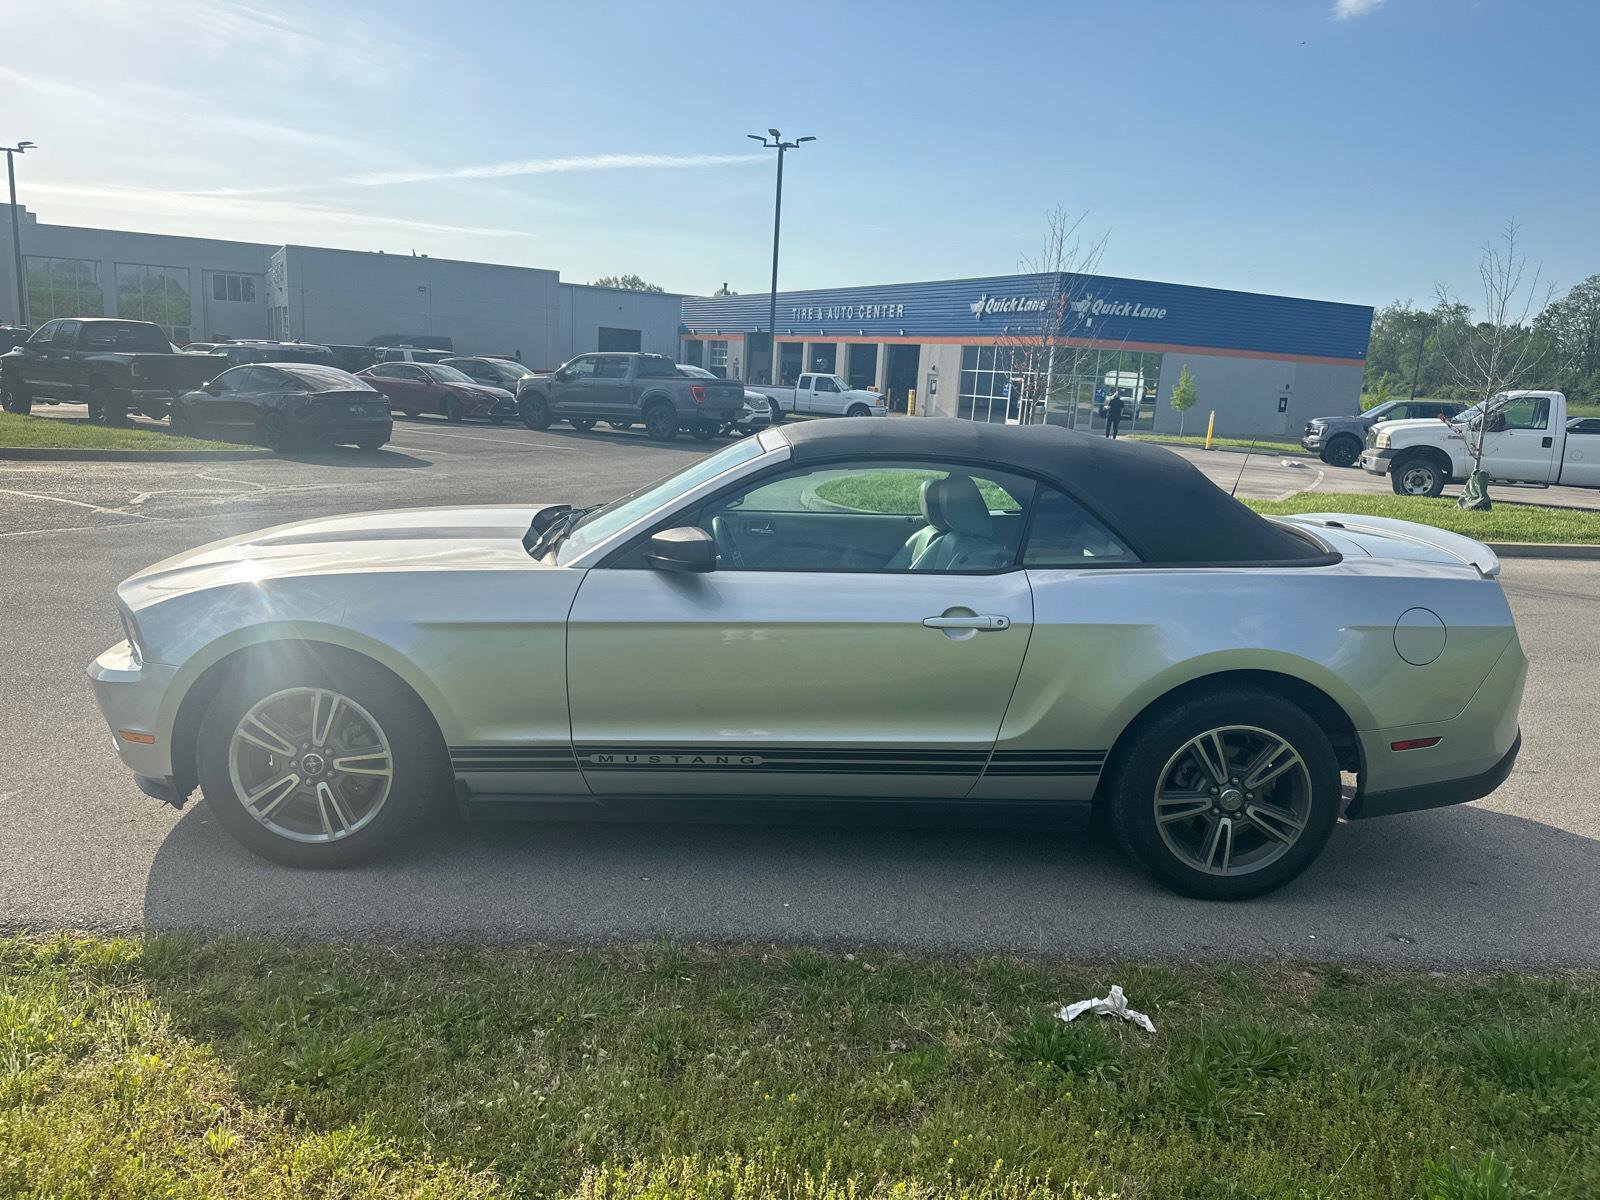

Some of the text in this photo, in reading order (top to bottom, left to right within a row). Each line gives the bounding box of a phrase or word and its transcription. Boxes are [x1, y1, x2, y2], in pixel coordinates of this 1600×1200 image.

[792, 307, 814, 320] TIRE
[827, 305, 854, 320] AUTO
[858, 304, 905, 319] CENTER
[985, 297, 1048, 315] Quick Lane
[1092, 299, 1167, 319] Quick Lane
[598, 754, 754, 764] MUSTANG
